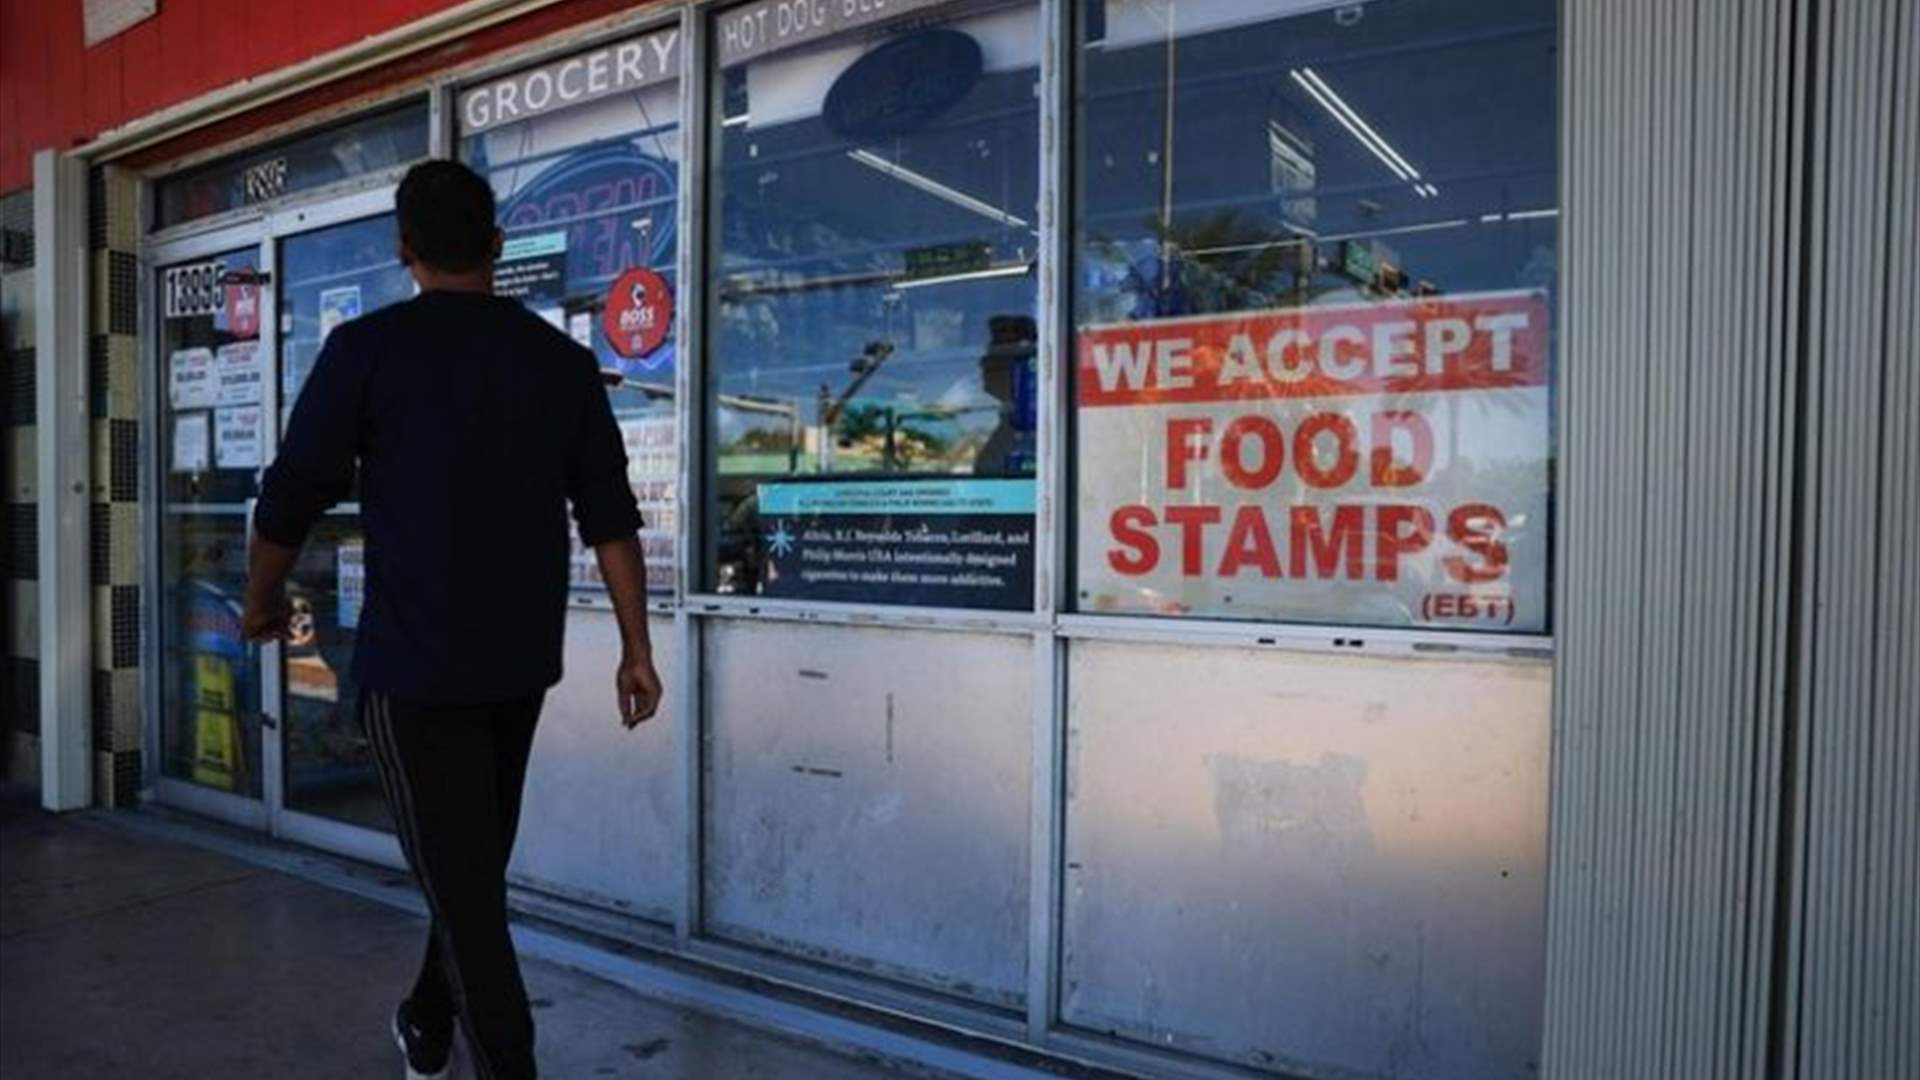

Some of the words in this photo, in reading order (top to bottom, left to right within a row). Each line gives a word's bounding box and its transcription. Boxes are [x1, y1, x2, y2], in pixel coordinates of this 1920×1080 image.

[724, 9, 767, 50] HOT
[777, 0, 825, 38] DOG
[466, 31, 678, 127] GROCERY
[1092, 338, 1196, 391] WE
[1217, 313, 1530, 384] ACCEPT
[1165, 411, 1434, 490] FOOD
[1107, 502, 1510, 583] STAMPS
[1421, 593, 1515, 626] (EBT)
